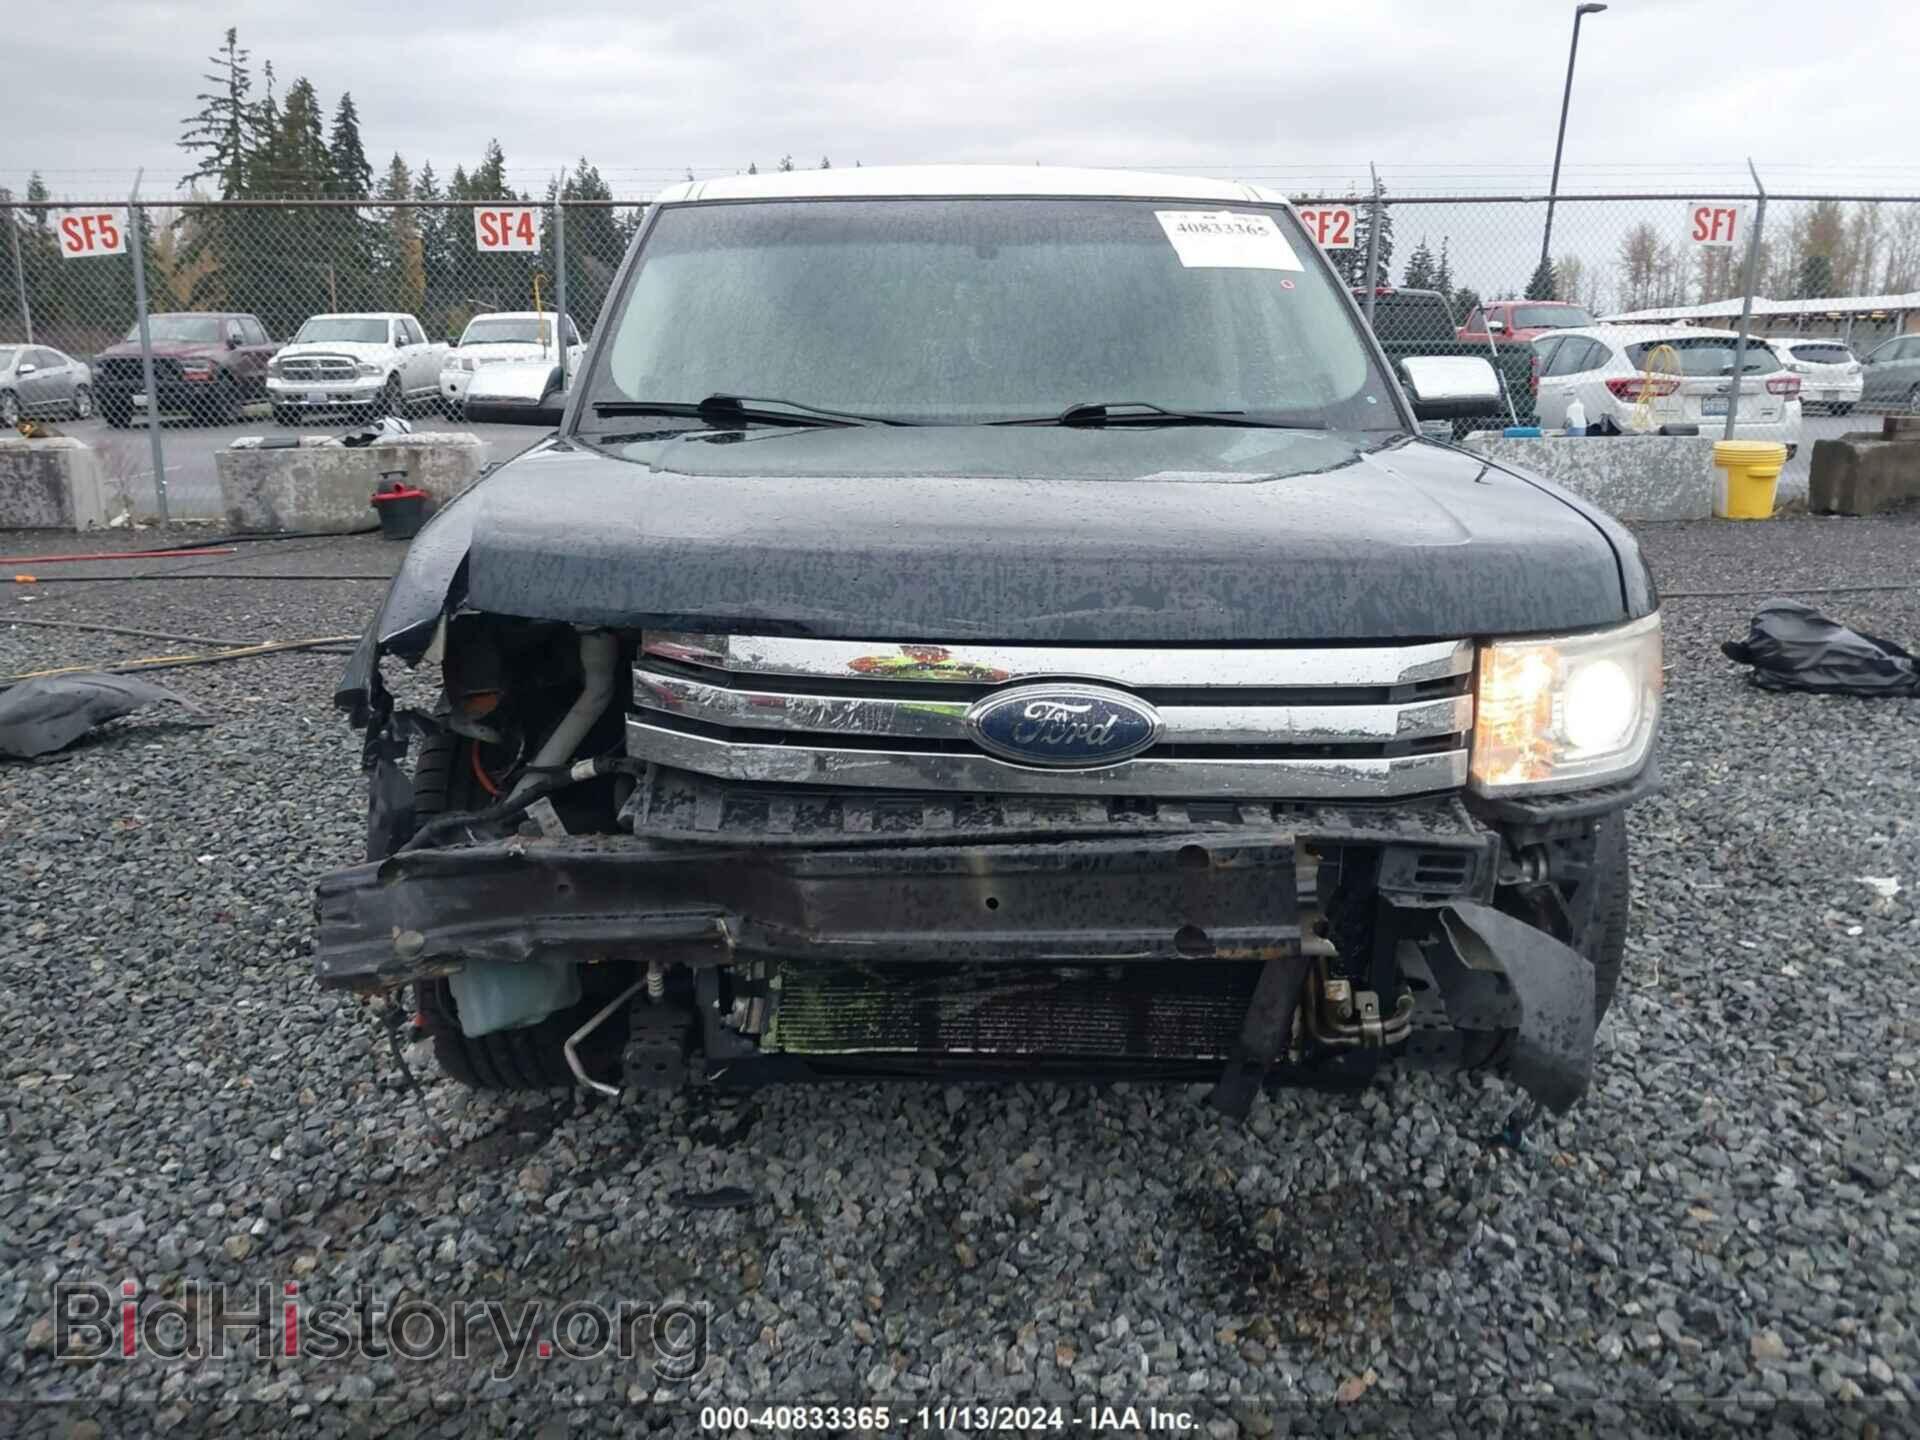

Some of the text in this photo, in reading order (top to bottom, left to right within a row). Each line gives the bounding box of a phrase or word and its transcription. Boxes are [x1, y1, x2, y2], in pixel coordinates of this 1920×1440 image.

[62, 214, 119, 252] SF5
[479, 211, 534, 246] SF4
[1177, 222, 1271, 237] 40833365
[1693, 207, 1736, 240] SF1
[1013, 701, 1118, 745] Ford
